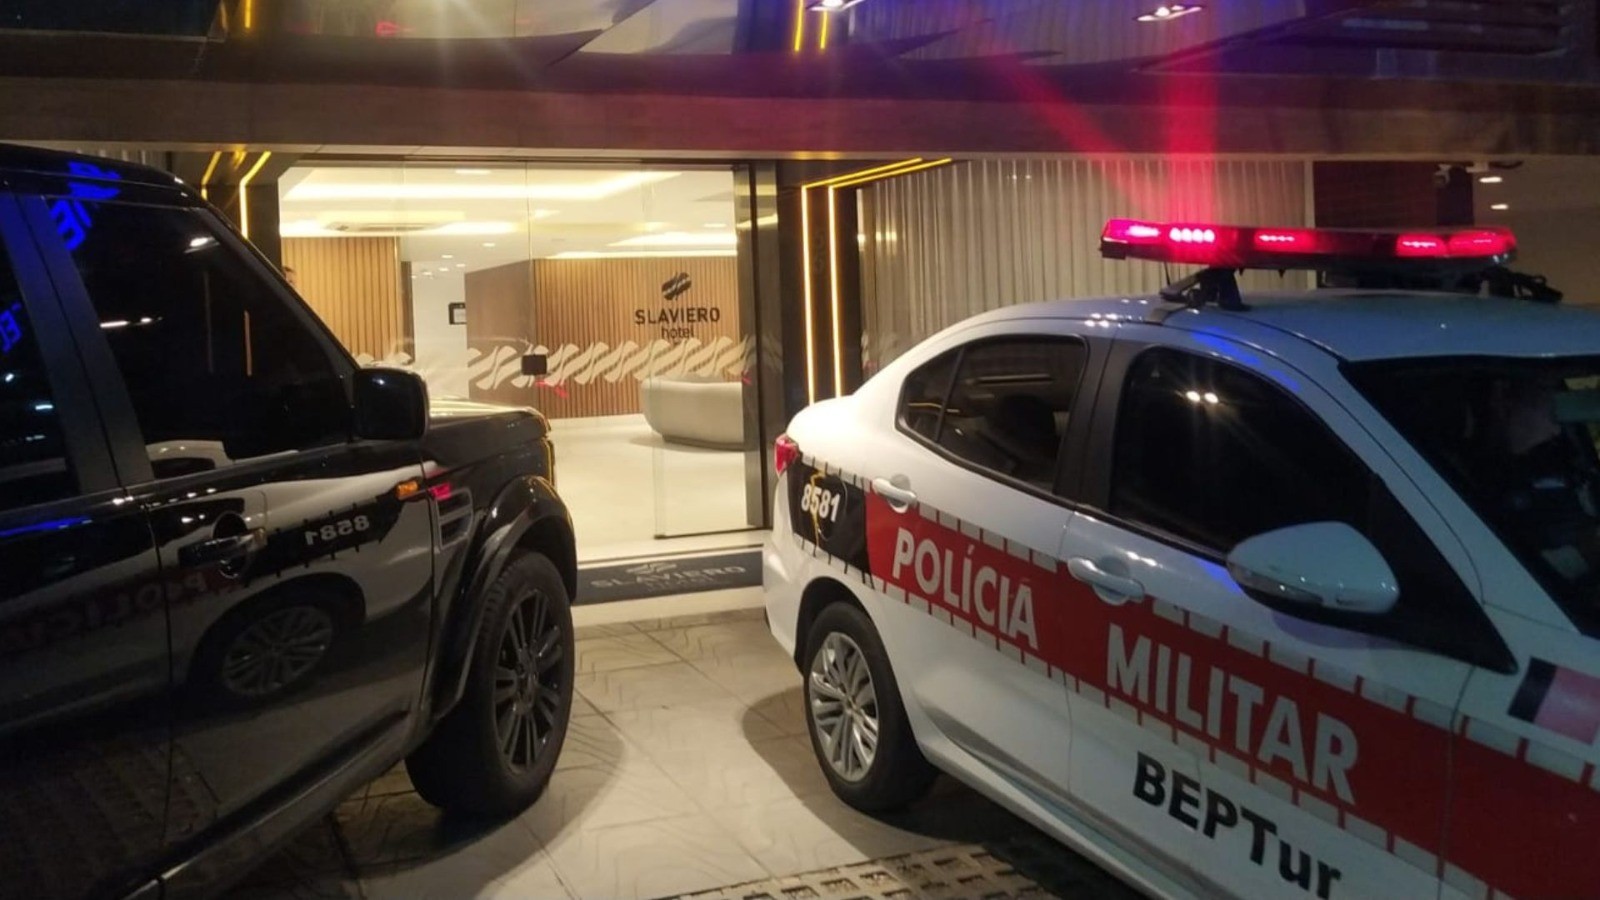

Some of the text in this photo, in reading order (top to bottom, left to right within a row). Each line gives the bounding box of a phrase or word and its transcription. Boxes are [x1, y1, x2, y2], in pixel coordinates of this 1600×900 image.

[635, 307, 720, 325] SLAVIERO
[661, 325, 694, 339] hotel
[801, 483, 841, 523] 8581
[892, 527, 1039, 650] POLÍCIA
[1106, 622, 1359, 805] MILITAR
[1132, 751, 1342, 899] BEPTur
